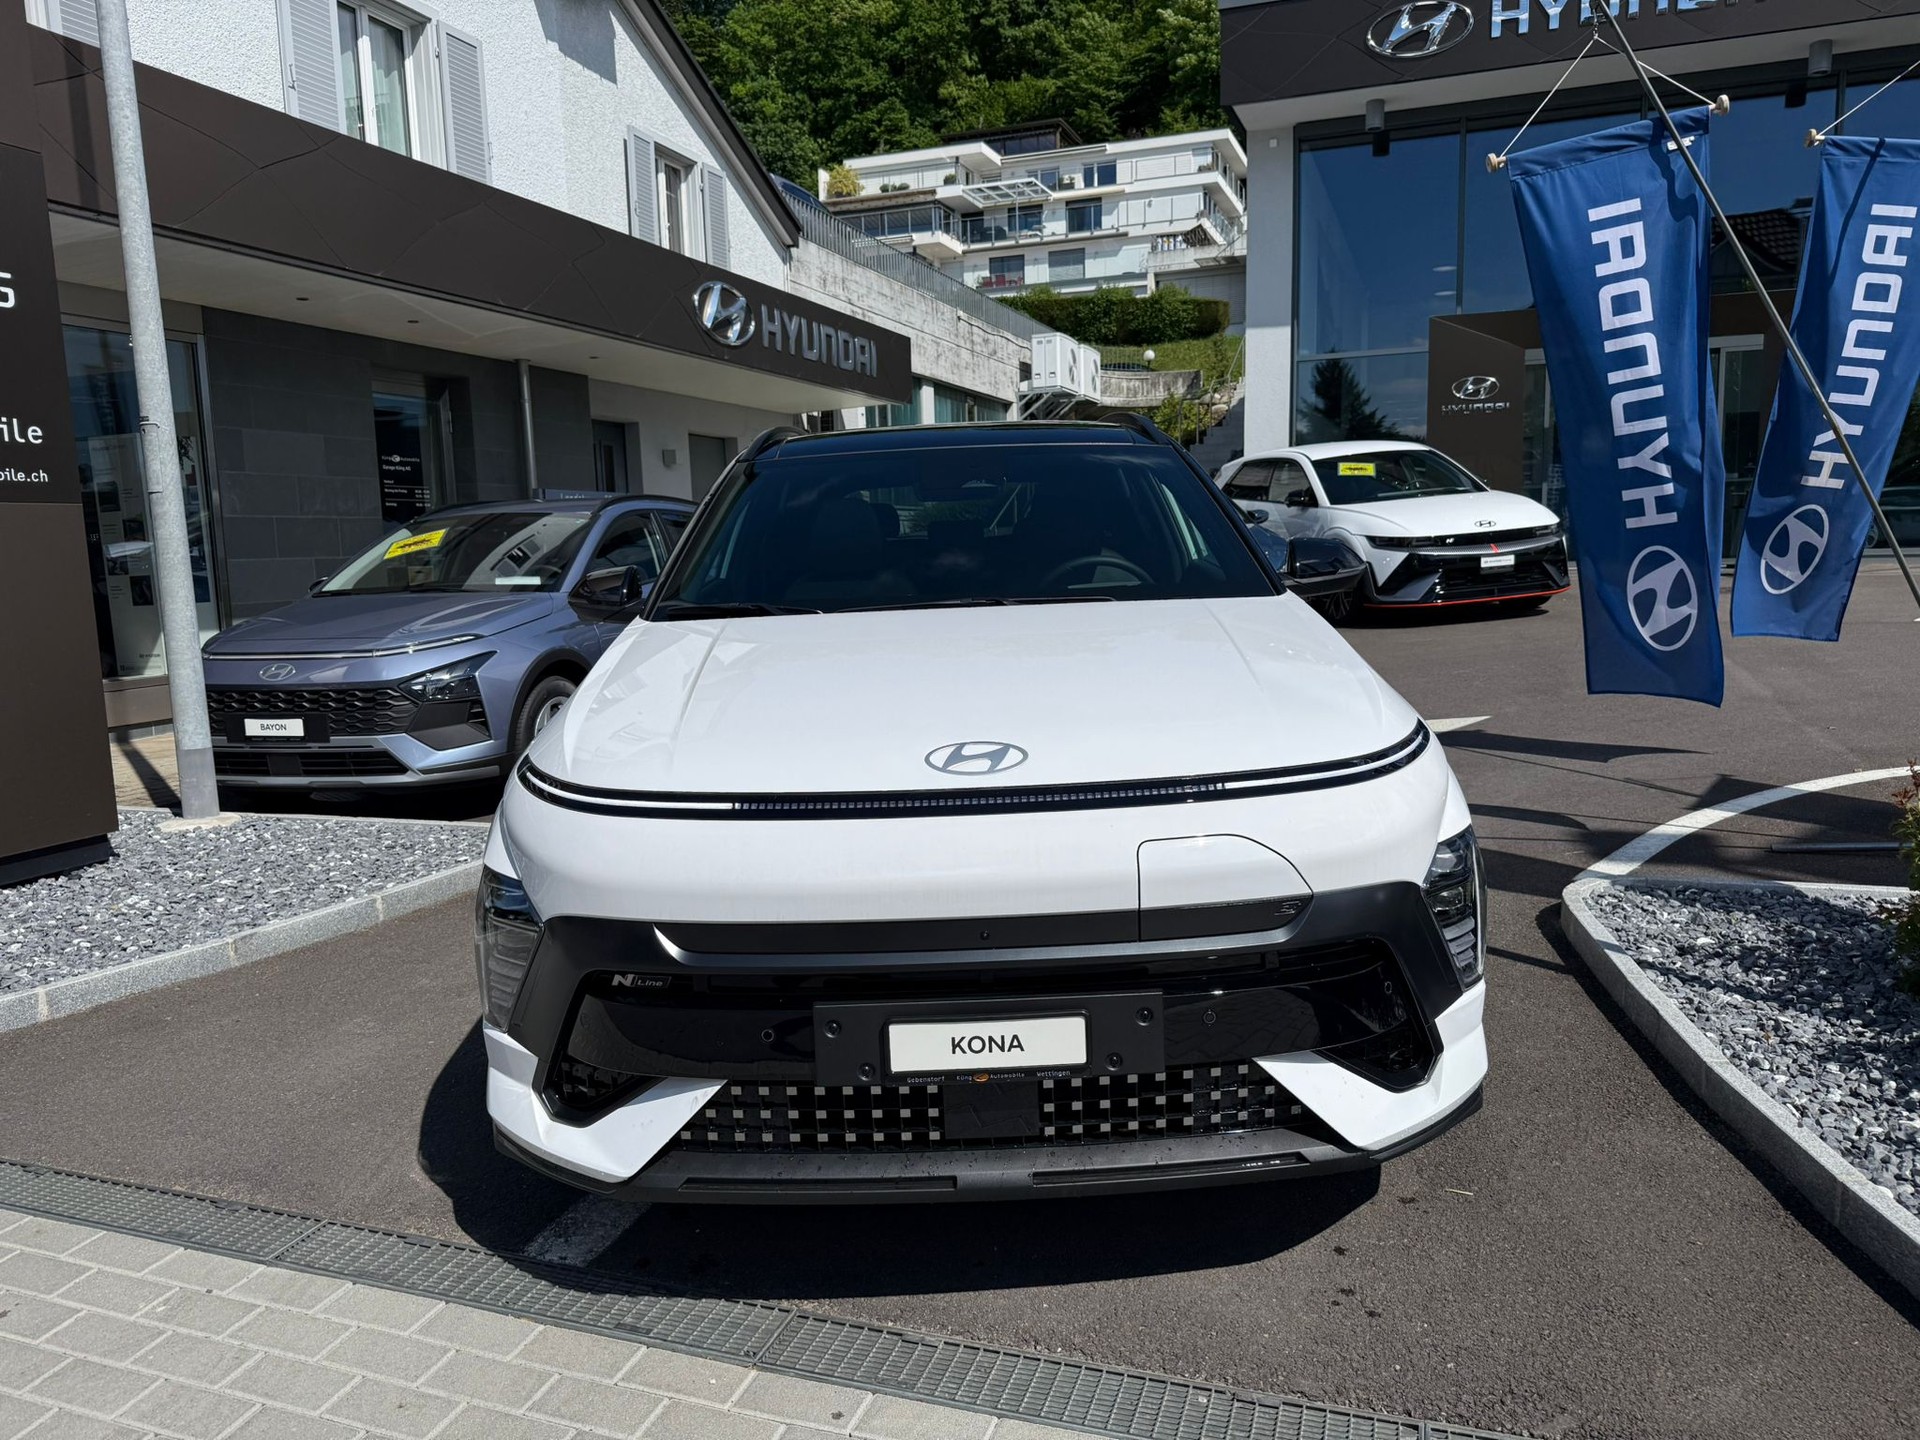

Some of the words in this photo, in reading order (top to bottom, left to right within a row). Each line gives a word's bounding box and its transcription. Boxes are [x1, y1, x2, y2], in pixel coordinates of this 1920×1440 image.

[761, 303, 877, 378] HYUNDAI
[1587, 197, 1679, 529] HYUNDAI
[1800, 203, 1918, 490] HYUNDAI
[260, 723, 287, 731] BAYON
[951, 1034, 1025, 1055] KONA
[1036, 1070, 1071, 1079] Wettingen
